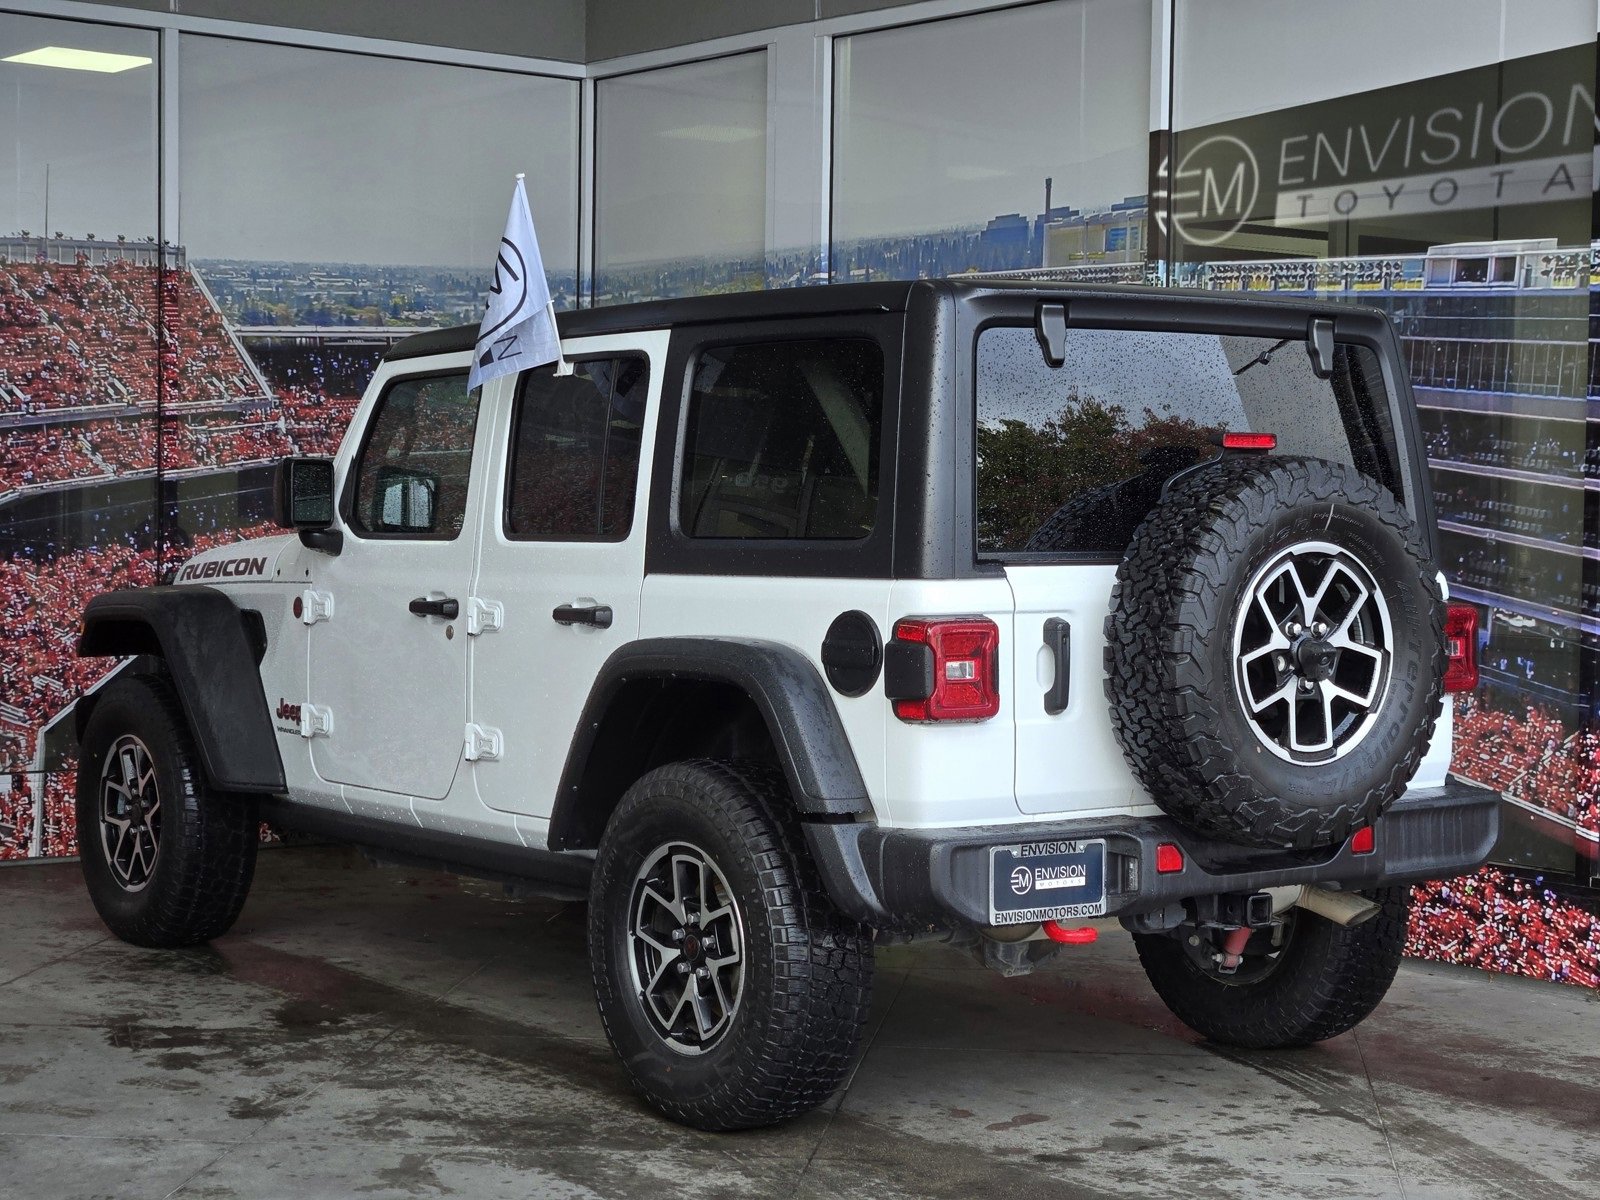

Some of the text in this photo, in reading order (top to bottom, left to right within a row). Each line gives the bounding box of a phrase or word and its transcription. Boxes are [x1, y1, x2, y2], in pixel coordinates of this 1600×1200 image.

[1278, 83, 1595, 186] ENVISION
[1296, 163, 1576, 218] TOYOTA
[180, 557, 268, 581] RUBICON
[276, 697, 302, 726] Jeep
[1020, 841, 1077, 857] ENVISION
[1035, 864, 1086, 880] ENVISION
[995, 904, 1102, 923] ENVISIONMOTORS.COM
